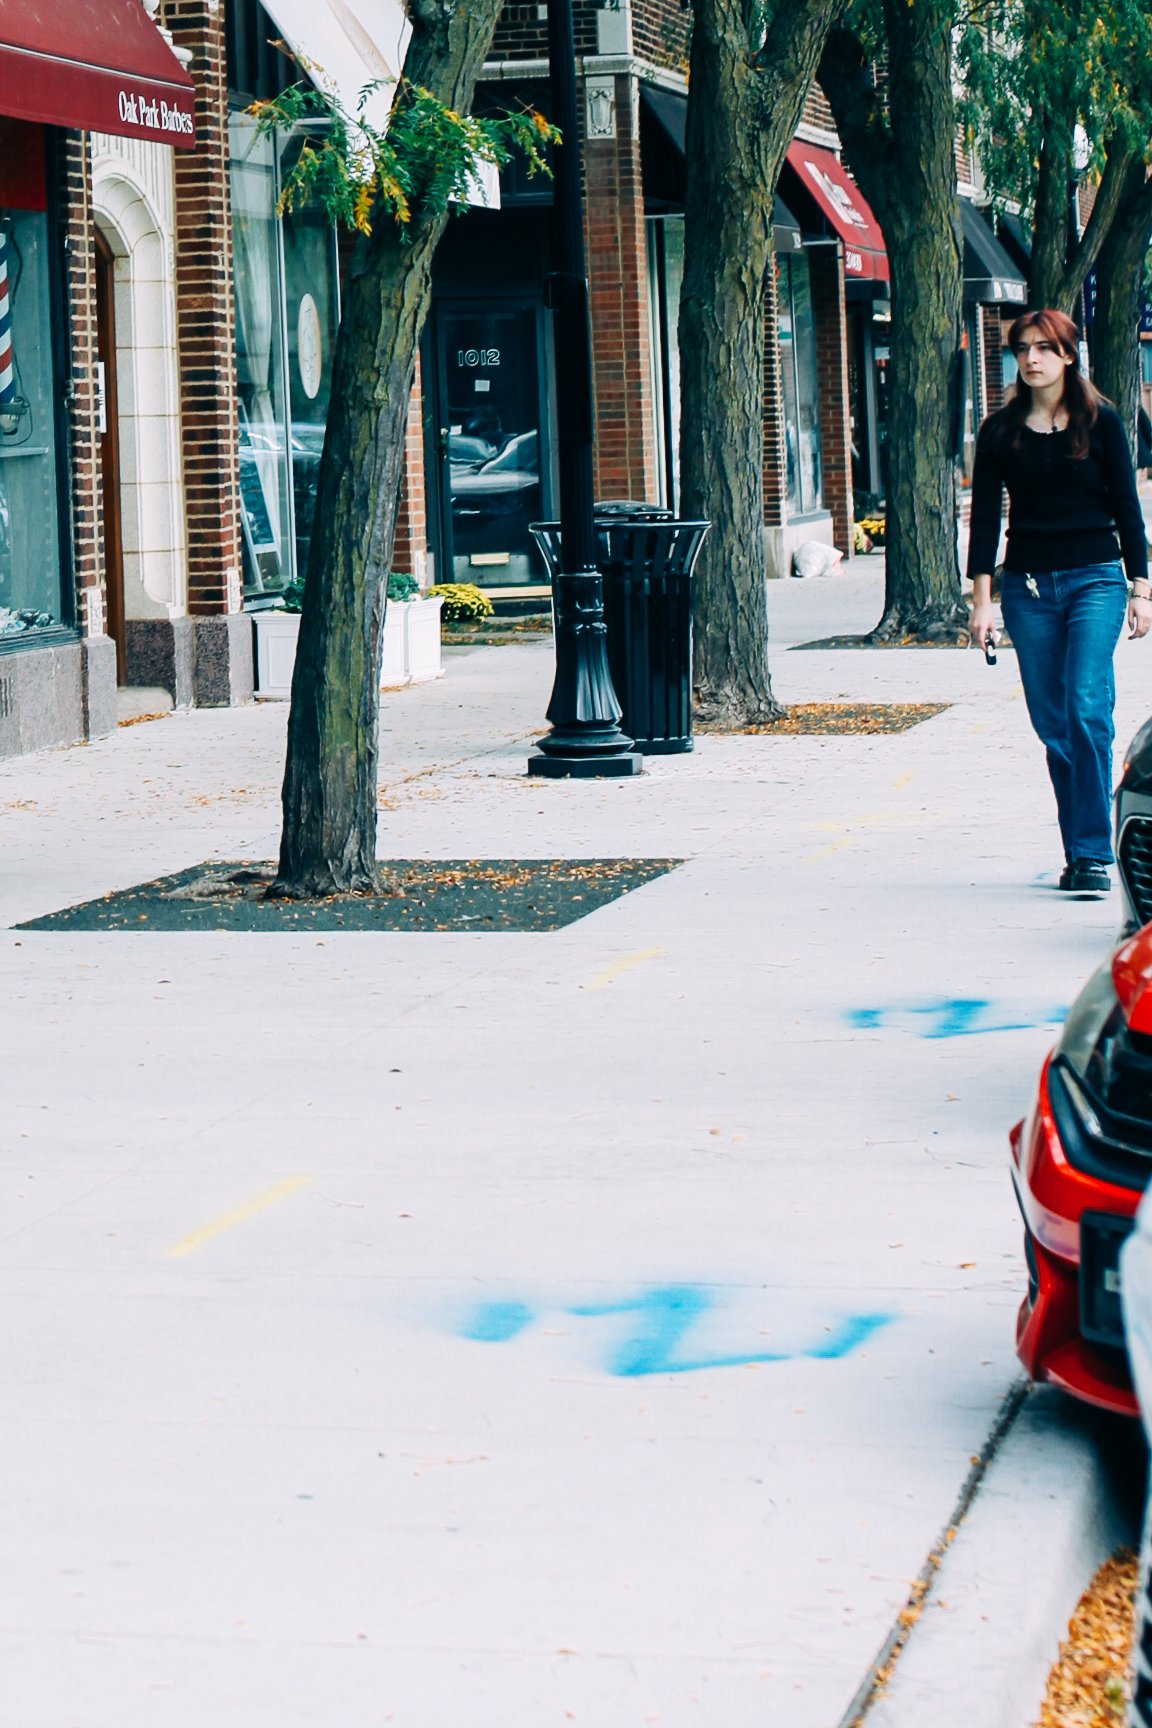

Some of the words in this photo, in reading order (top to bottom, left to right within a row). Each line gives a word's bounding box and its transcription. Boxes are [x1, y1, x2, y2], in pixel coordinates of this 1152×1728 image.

[118, 90, 139, 124] Oak
[138, 95, 161, 129] Park
[160, 100, 194, 134] Barbers
[458, 348, 501, 367] 1012
